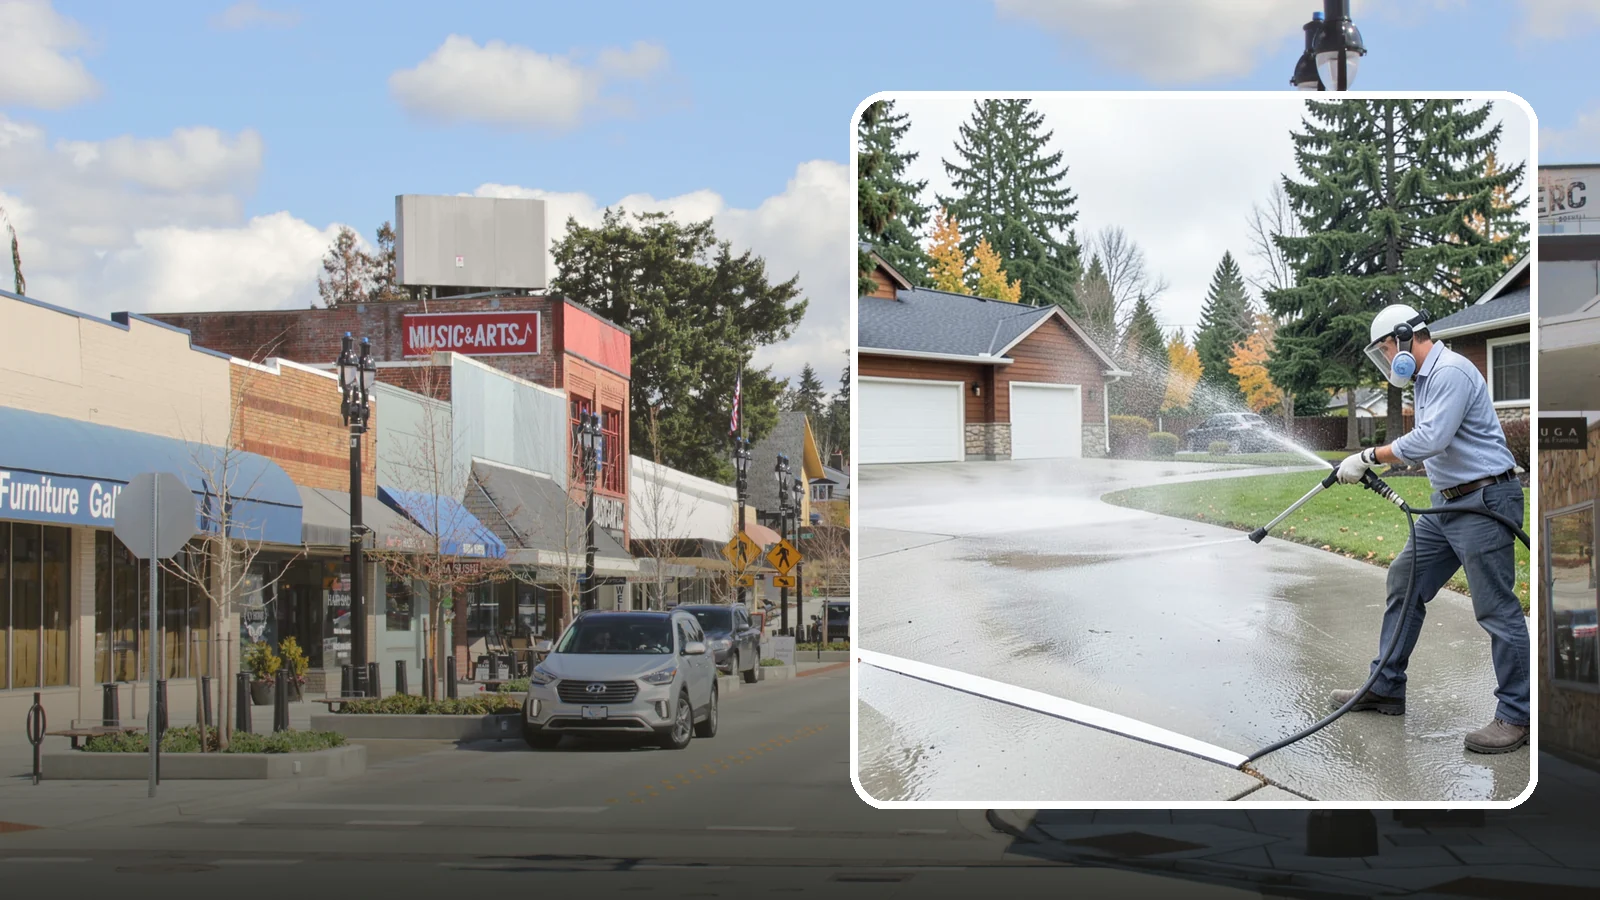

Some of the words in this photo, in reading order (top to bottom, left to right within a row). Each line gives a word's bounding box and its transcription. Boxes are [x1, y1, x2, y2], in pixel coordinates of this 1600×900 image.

[409, 323, 519, 348] MUSIC&ARTS
[0, 471, 79, 515] Furniture
[89, 482, 122, 519] Gal
